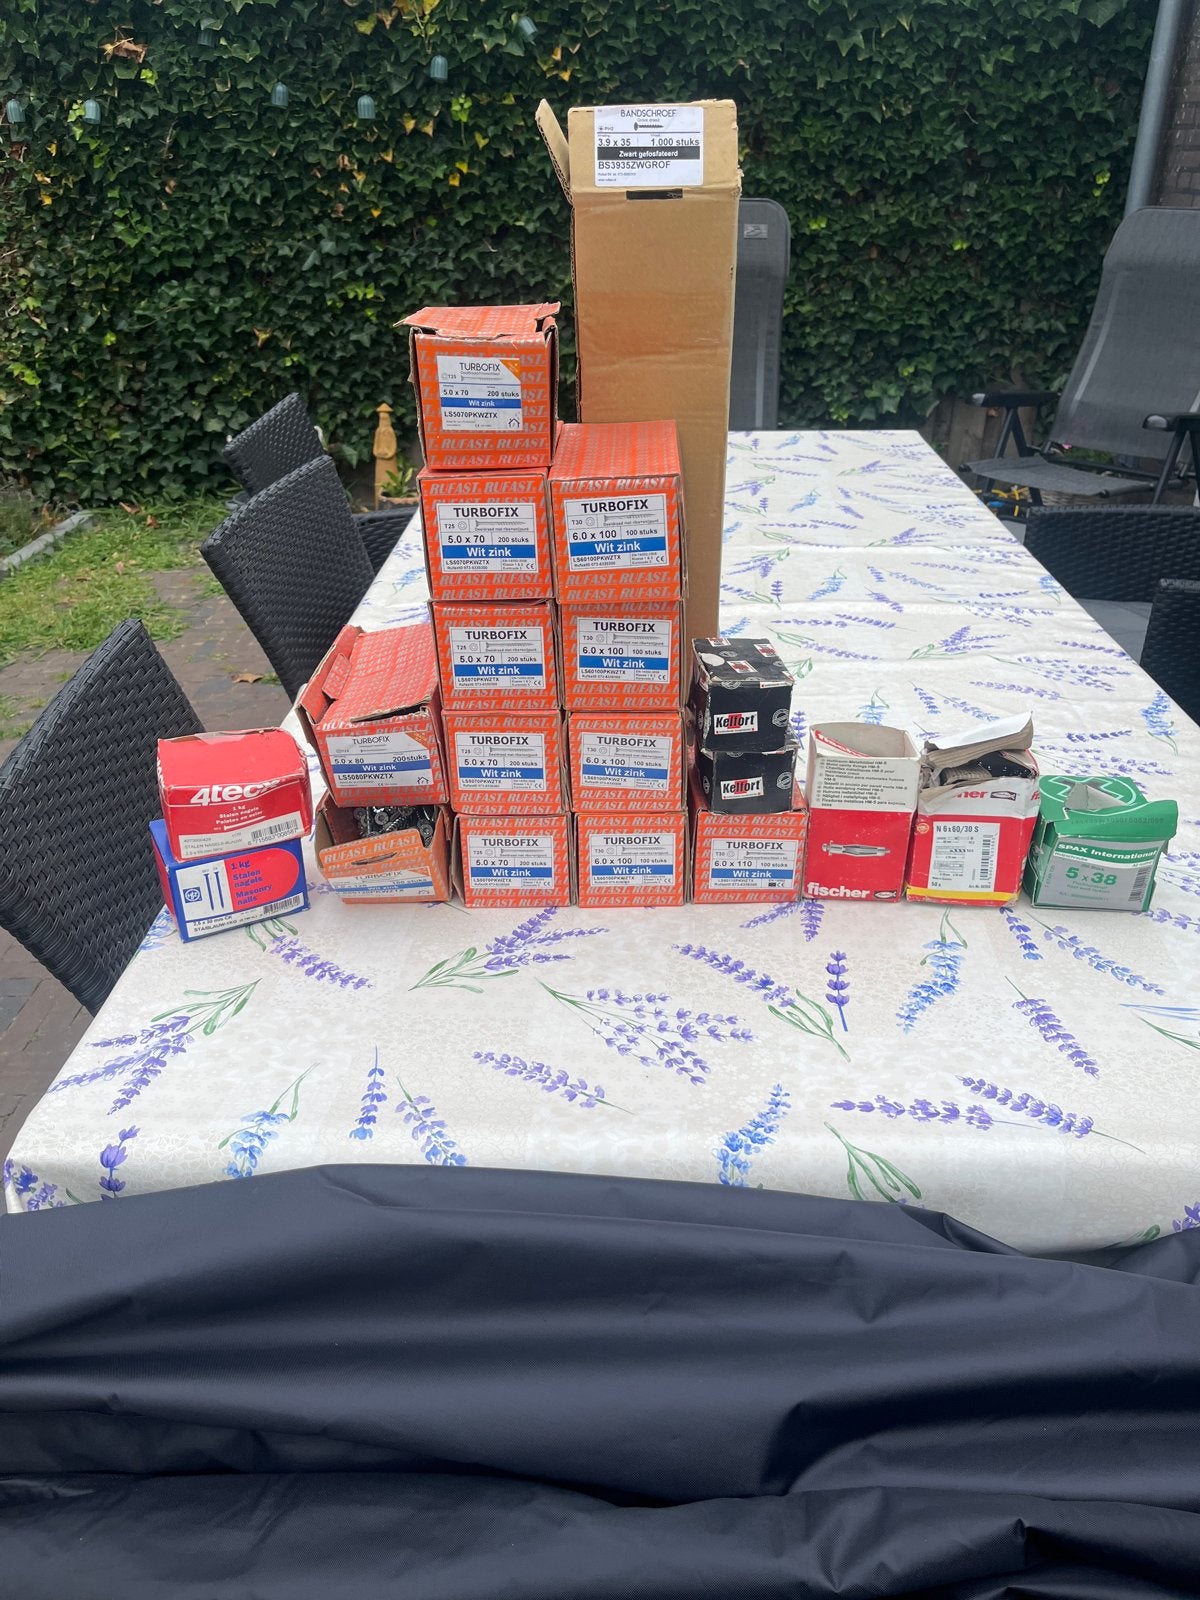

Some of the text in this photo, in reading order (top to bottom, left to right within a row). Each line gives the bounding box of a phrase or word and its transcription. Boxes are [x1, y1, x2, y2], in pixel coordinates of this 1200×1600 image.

[620, 109, 676, 117] BANDSCHROEF
[598, 161, 671, 169] BS3935ZWGROF
[460, 363, 500, 371] TURBOFIX
[582, 499, 648, 513] TURBOFIX
[454, 508, 519, 517] TURBOFIX
[572, 532, 587, 540] 6.0
[600, 530, 616, 538] 100
[467, 547, 511, 556] Wit zink
[595, 541, 640, 553] Wit zink
[593, 622, 655, 632] TURBOFIX
[465, 631, 527, 639] TURBOFIX
[603, 658, 645, 668] Wit zink
[478, 666, 520, 674] Wit zink
[716, 714, 755, 728] Kelfort
[352, 736, 390, 745] TURBOFIX
[470, 736, 528, 745] TURBOFIX
[597, 736, 656, 747] TURBOFIX
[605, 767, 645, 777] Wit zink
[723, 781, 760, 793] Kelfort
[1058, 844, 1088, 853] SPAX
[1091, 849, 1159, 859] International
[239, 861, 250, 869] kg
[233, 870, 261, 880] Stalen
[1066, 867, 1079, 878] 5
[1090, 872, 1117, 885] 38
[234, 877, 263, 888] nagels
[236, 885, 272, 898] Masonry
[807, 882, 870, 898] fischer
[237, 896, 258, 905] nails
